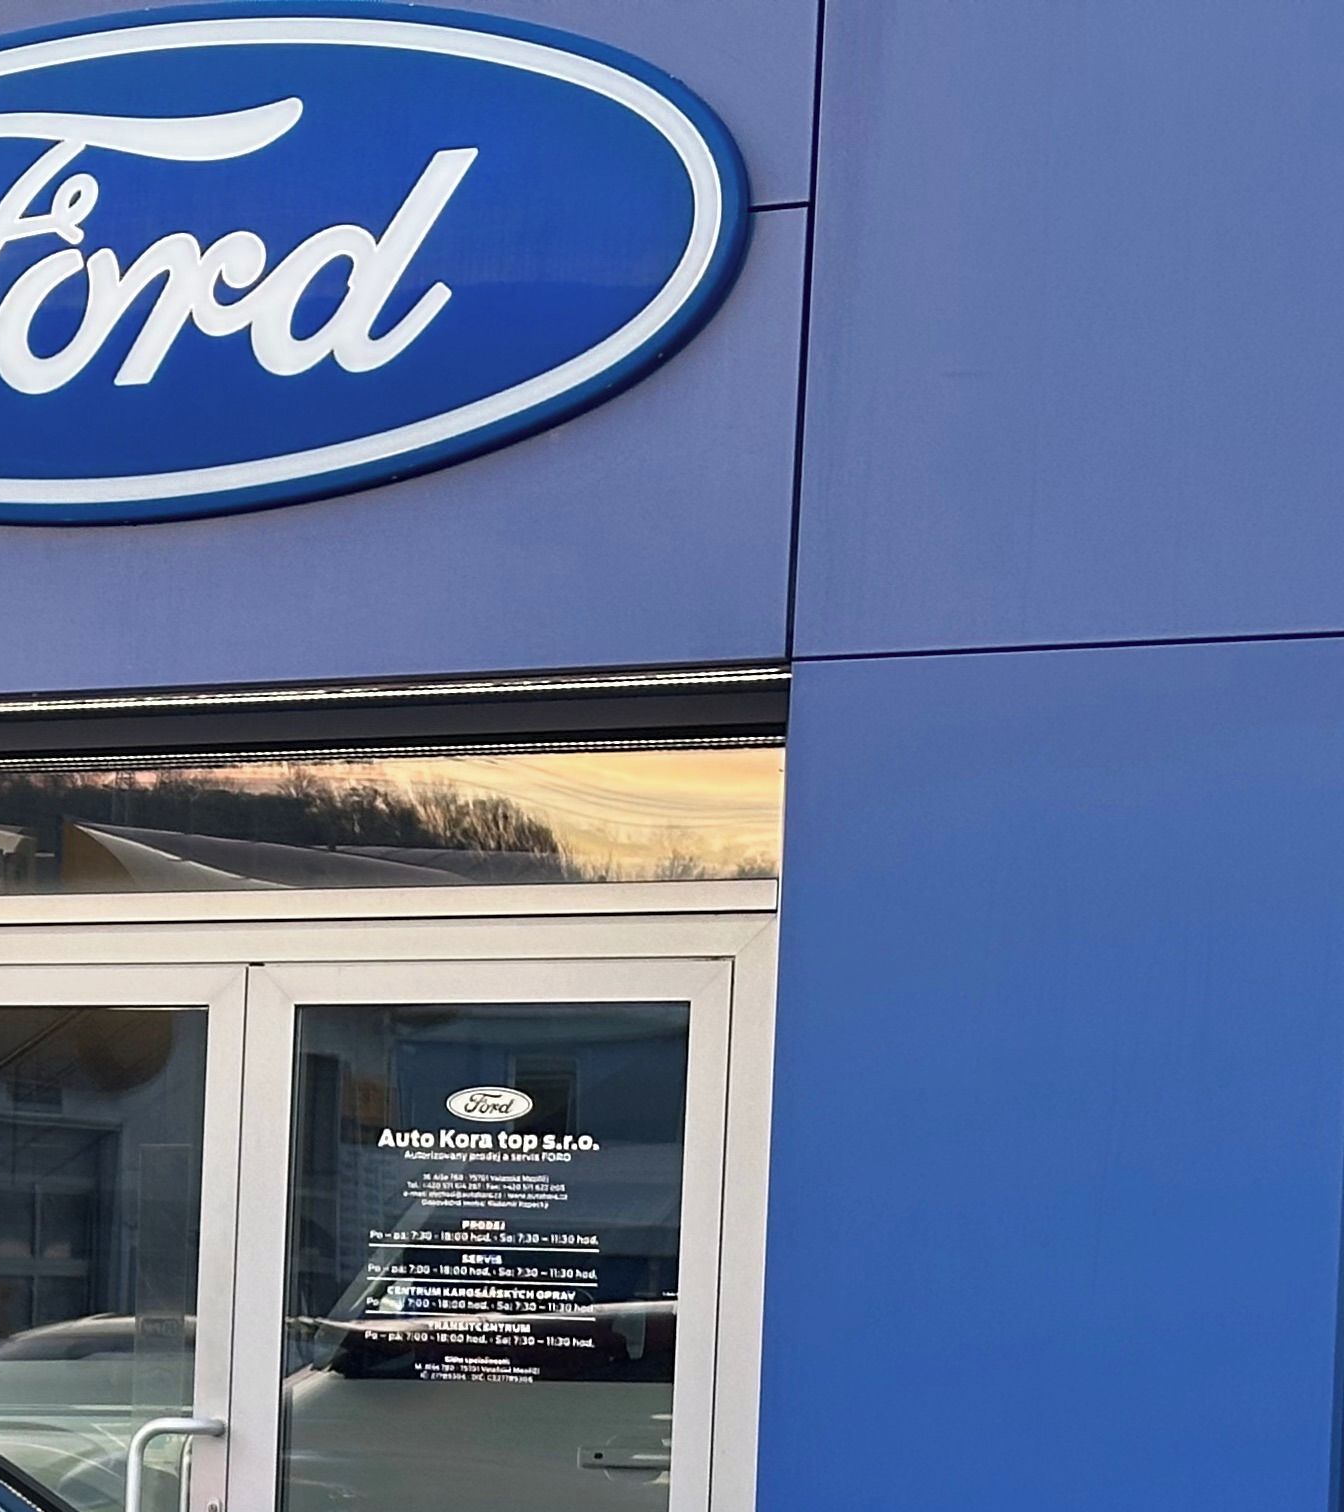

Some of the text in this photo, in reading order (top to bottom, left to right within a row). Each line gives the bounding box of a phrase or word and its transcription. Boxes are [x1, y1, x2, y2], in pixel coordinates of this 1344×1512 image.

[463, 1092, 515, 1114] Ford
[377, 1127, 600, 1153] Auto Kora top s.r.o.
[462, 1219, 505, 1231] PRODEJ
[370, 1229, 383, 1239] Po
[412, 1230, 432, 1241] 7:30
[440, 1231, 468, 1242] 18:00
[550, 1234, 575, 1245] 11:30
[462, 1253, 502, 1265] SERVIS
[368, 1263, 381, 1273] Po
[409, 1264, 430, 1275] 7:00
[439, 1265, 467, 1276] 18:00
[549, 1268, 574, 1279] 11:30
[387, 1285, 442, 1297] CENTRUM
[536, 1289, 576, 1301] OPRAV
[366, 1297, 379, 1307] Po
[364, 1331, 378, 1341] Po
[436, 1333, 464, 1344] 18:00
